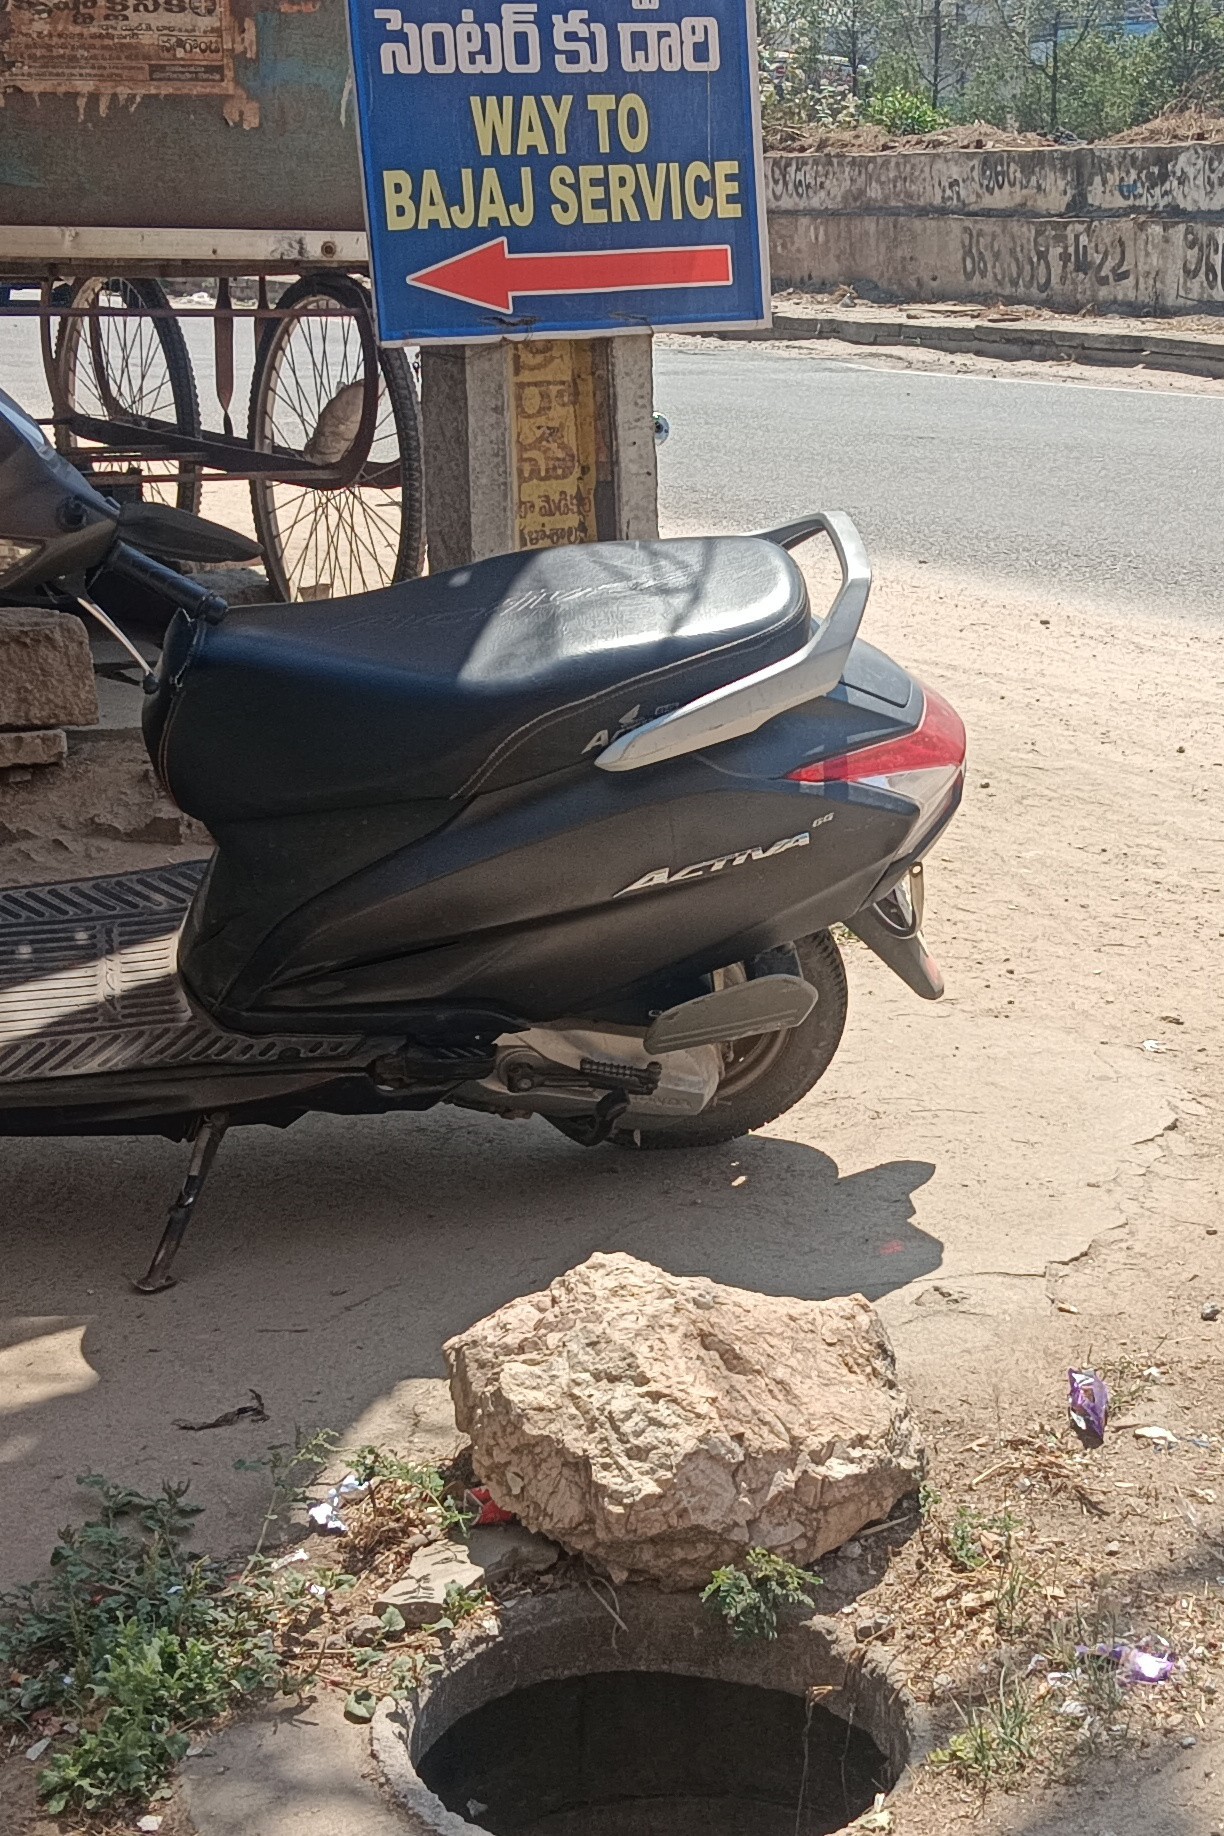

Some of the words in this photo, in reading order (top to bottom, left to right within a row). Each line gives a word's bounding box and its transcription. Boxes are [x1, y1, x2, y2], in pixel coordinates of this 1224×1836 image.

[374, 3, 541, 74] సెంటర్
[552, 9, 608, 73] కు
[617, 16, 721, 72] దారి
[470, 94, 573, 156] WAY
[587, 92, 649, 153] TO
[382, 166, 534, 231] BAJAJ
[549, 160, 743, 226] SERVICE
[812, 812, 834, 828] 6G
[612, 832, 810, 899] ACTIVA
